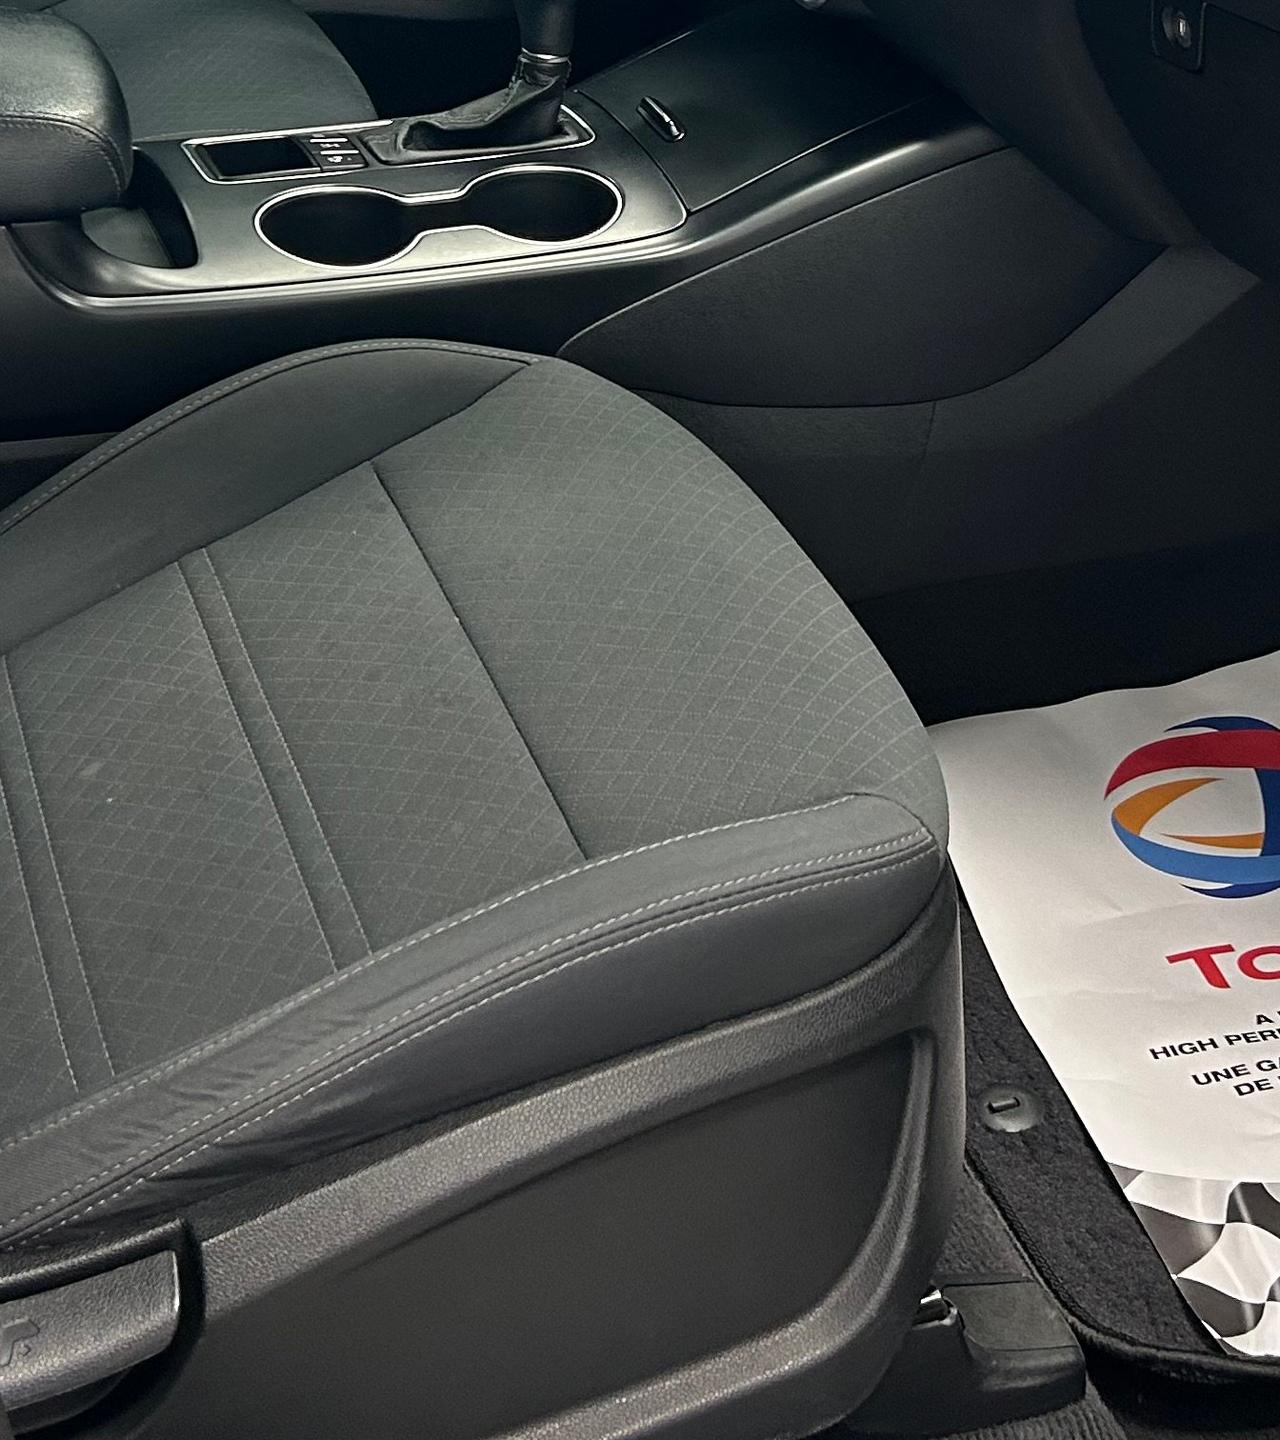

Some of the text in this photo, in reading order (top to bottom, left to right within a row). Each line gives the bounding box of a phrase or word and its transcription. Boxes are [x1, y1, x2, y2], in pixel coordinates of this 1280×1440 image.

[1255, 1014, 1274, 1025] A
[1149, 1038, 1219, 1060] HIGH
[1192, 1064, 1251, 1086] UNE
[1233, 1078, 1274, 1096] DE
